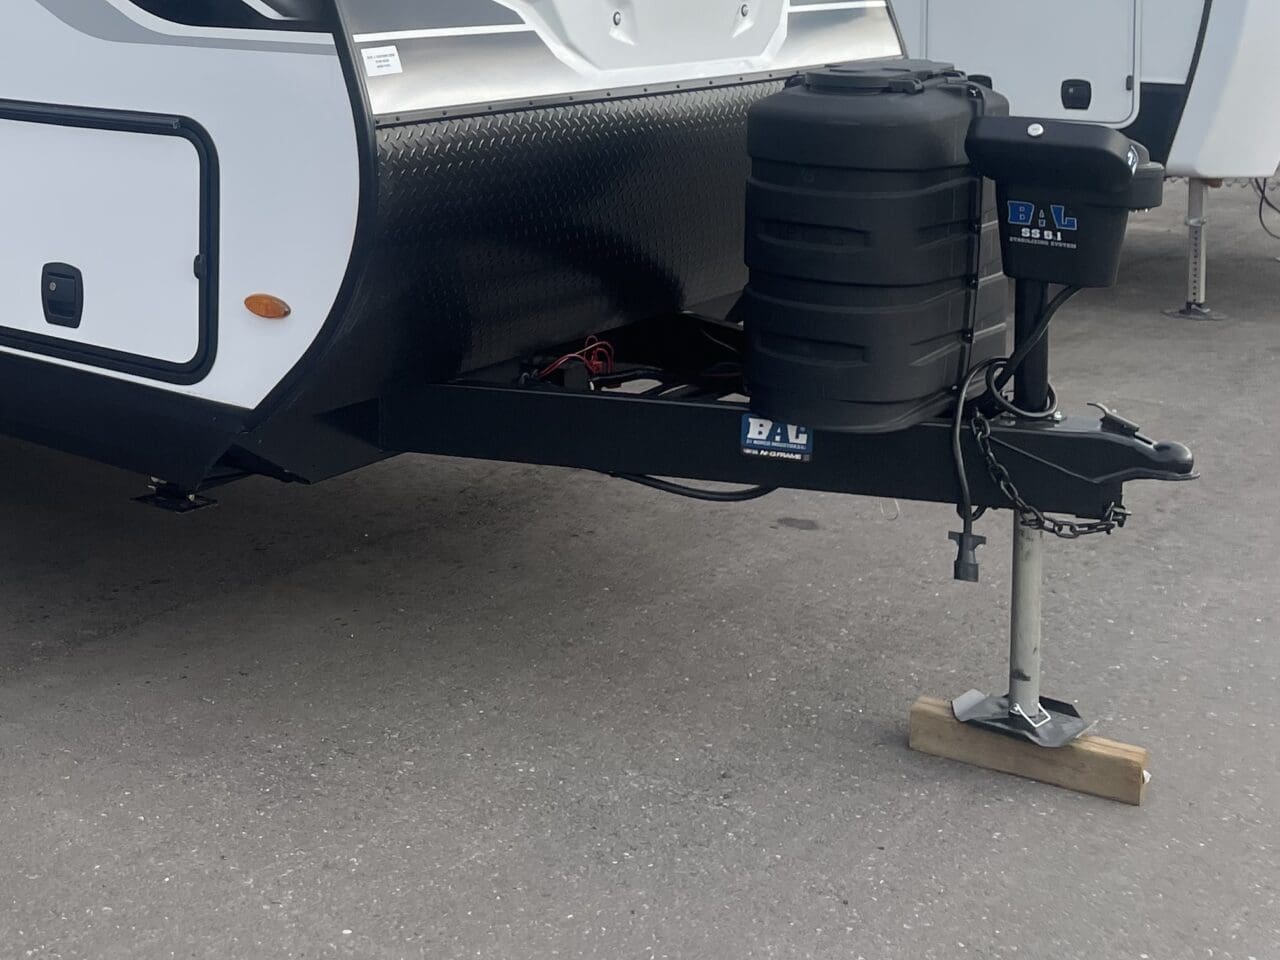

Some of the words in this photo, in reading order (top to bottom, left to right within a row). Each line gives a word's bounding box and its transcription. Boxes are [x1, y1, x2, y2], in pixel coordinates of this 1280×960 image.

[1007, 200, 1078, 231] BAL
[1021, 227, 1041, 239] SS
[747, 417, 808, 445] BAL
